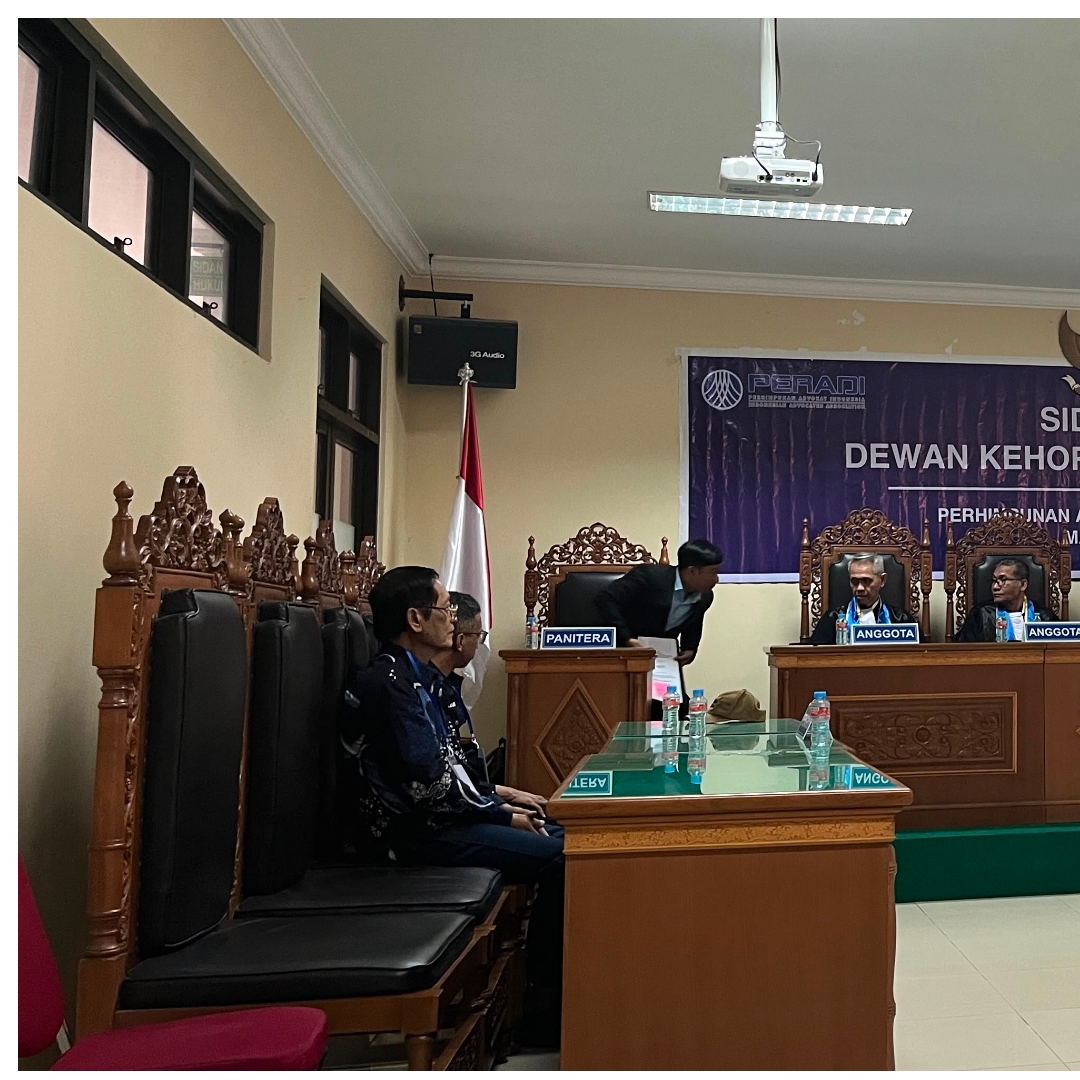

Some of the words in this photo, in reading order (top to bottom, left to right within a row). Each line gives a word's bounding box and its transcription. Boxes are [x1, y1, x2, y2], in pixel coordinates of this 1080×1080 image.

[482, 351, 505, 359] Audio
[748, 374, 866, 396] PERADI
[845, 442, 968, 470] DEWAN
[546, 633, 610, 644] PANITERA
[856, 628, 915, 639] ANGGOTA
